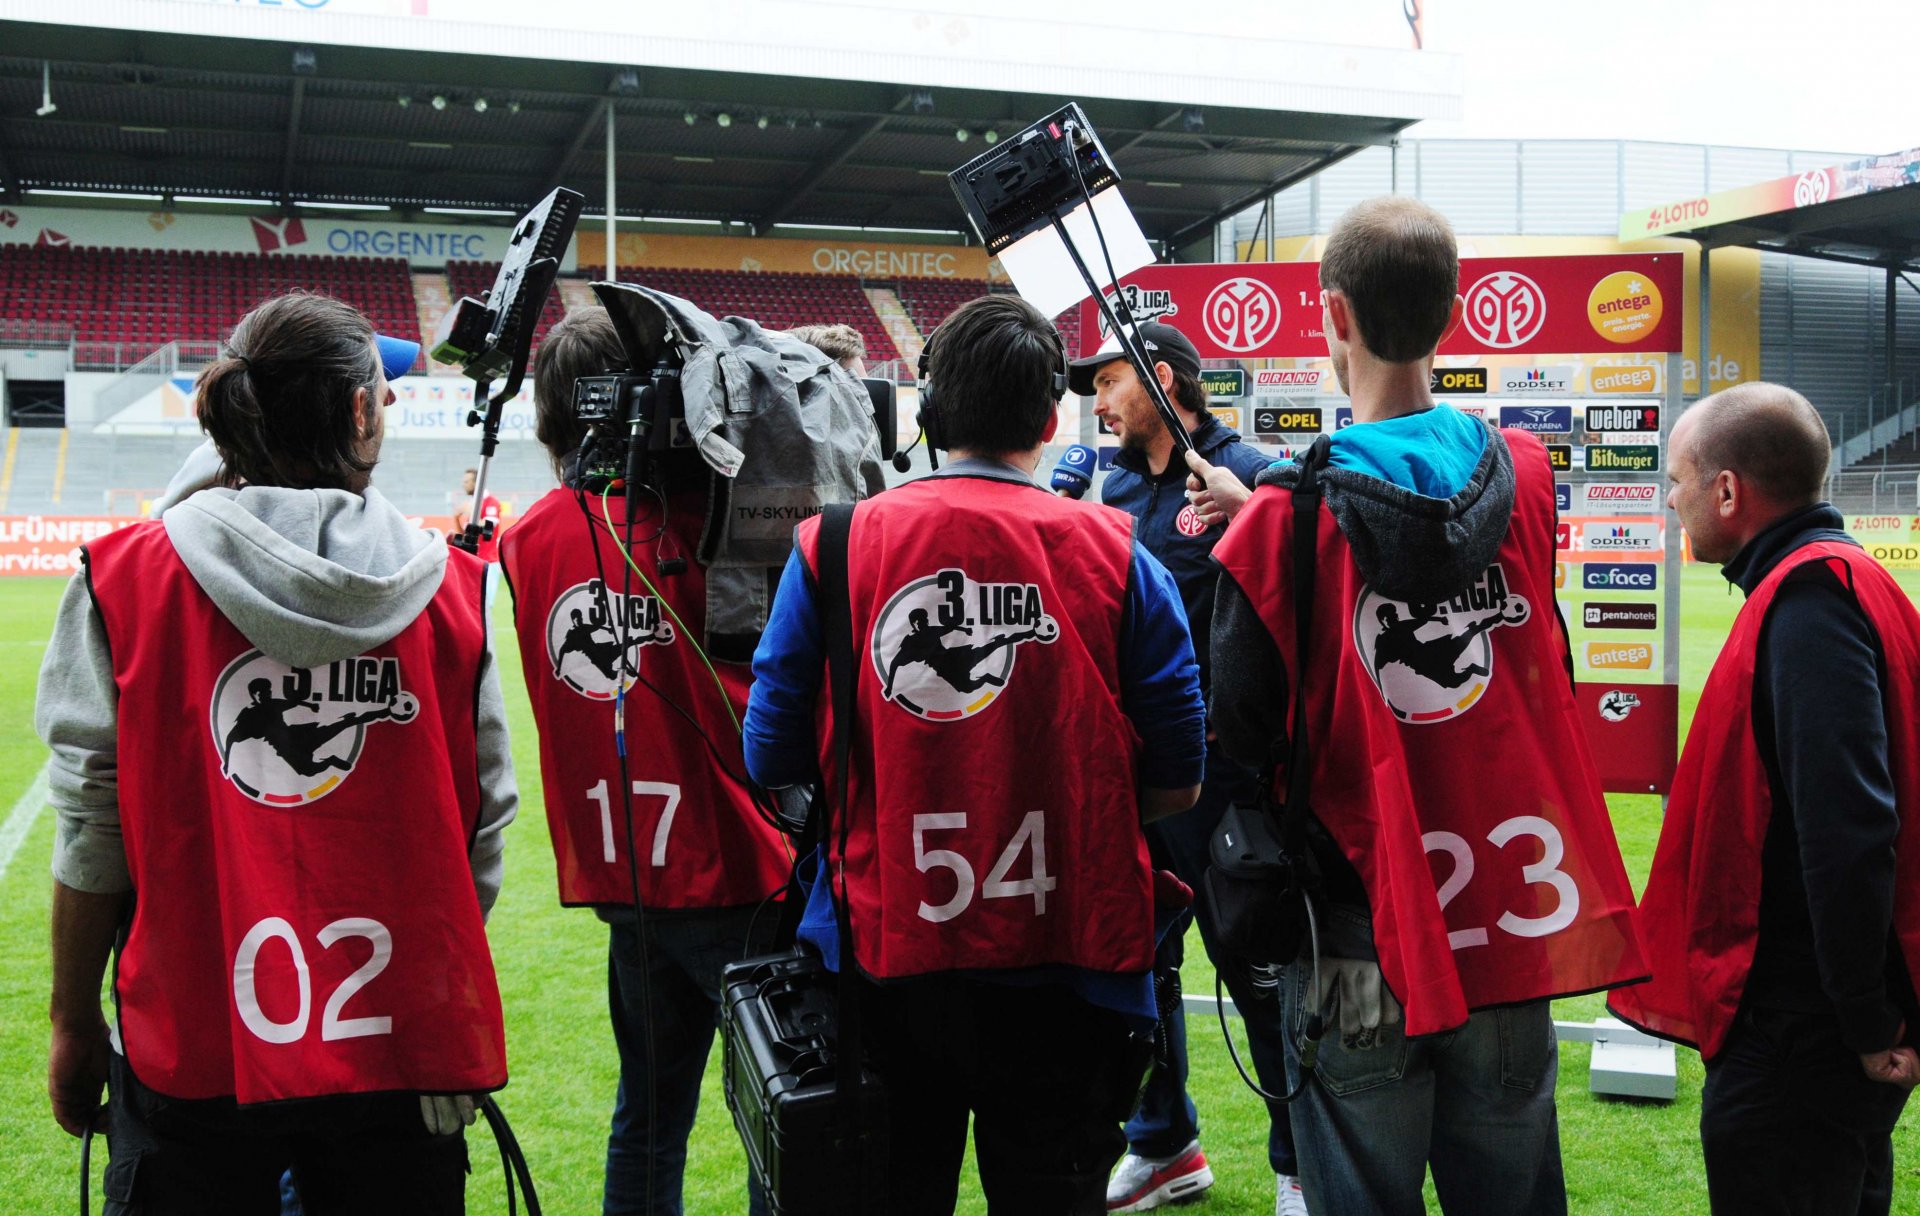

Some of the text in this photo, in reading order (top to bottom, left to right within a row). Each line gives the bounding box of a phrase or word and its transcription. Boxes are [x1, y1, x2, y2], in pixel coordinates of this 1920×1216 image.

[1664, 198, 1709, 224] LOTTO
[327, 228, 485, 258] ORGENTEC
[813, 248, 957, 276] ORGENTEC
[1143, 291, 1170, 309] LIGA
[1299, 291, 1314, 306] 1.
[1597, 295, 1651, 314] entega
[1258, 372, 1319, 383] URANO
[1442, 374, 1484, 388] OPEL
[1594, 369, 1651, 390] entega
[1200, 381, 1237, 395] urger
[402, 409, 446, 427] Just
[1279, 414, 1319, 428] OPEL
[1590, 406, 1642, 430] weber
[1551, 451, 1569, 465] EL
[1591, 448, 1652, 469] Bitburger
[1588, 487, 1655, 498] URANO
[1866, 517, 1901, 529] LOTTO
[1873, 547, 1918, 560] ODD
[1587, 568, 1652, 585] coface
[938, 571, 1043, 627] 3. LIGA
[615, 594, 661, 630] LGA
[1602, 611, 1655, 621] pentahotels
[1591, 647, 1648, 665] entega
[329, 658, 399, 703] LIGA
[586, 779, 681, 866] 17
[913, 810, 1057, 923] 54
[1421, 815, 1580, 950] 23
[233, 917, 393, 1044] 02
